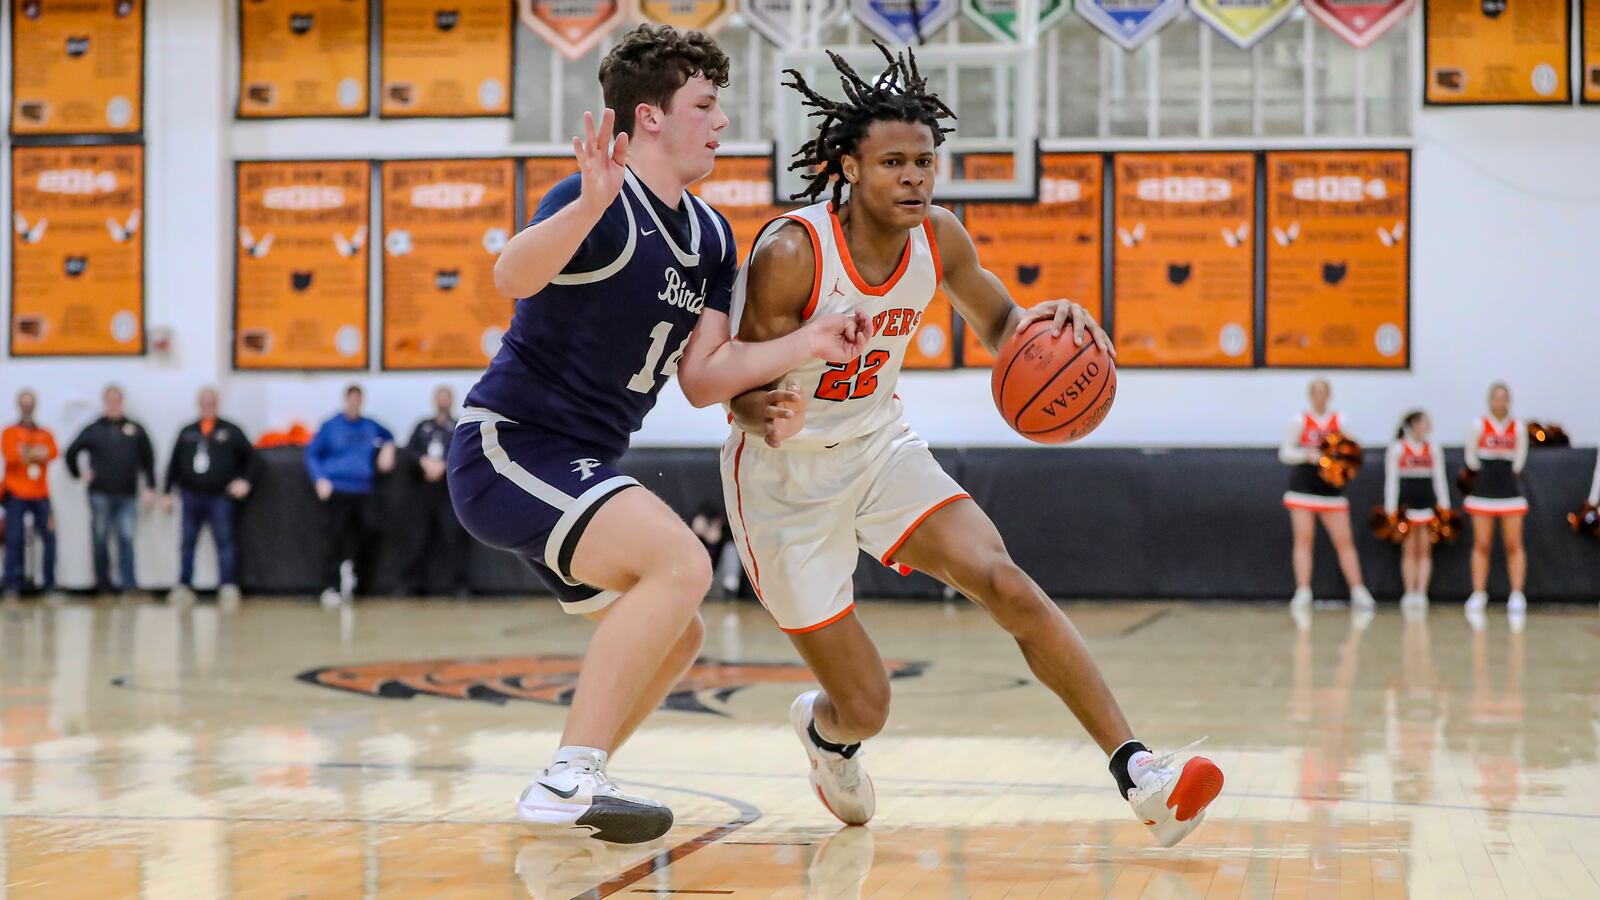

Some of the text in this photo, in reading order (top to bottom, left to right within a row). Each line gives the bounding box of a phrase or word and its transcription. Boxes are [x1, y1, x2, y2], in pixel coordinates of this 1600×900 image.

[1137, 176, 1232, 202] 2023
[1292, 176, 1387, 202] 2024
[814, 349, 890, 402] 22
[1041, 361, 1099, 417] OHSAA
